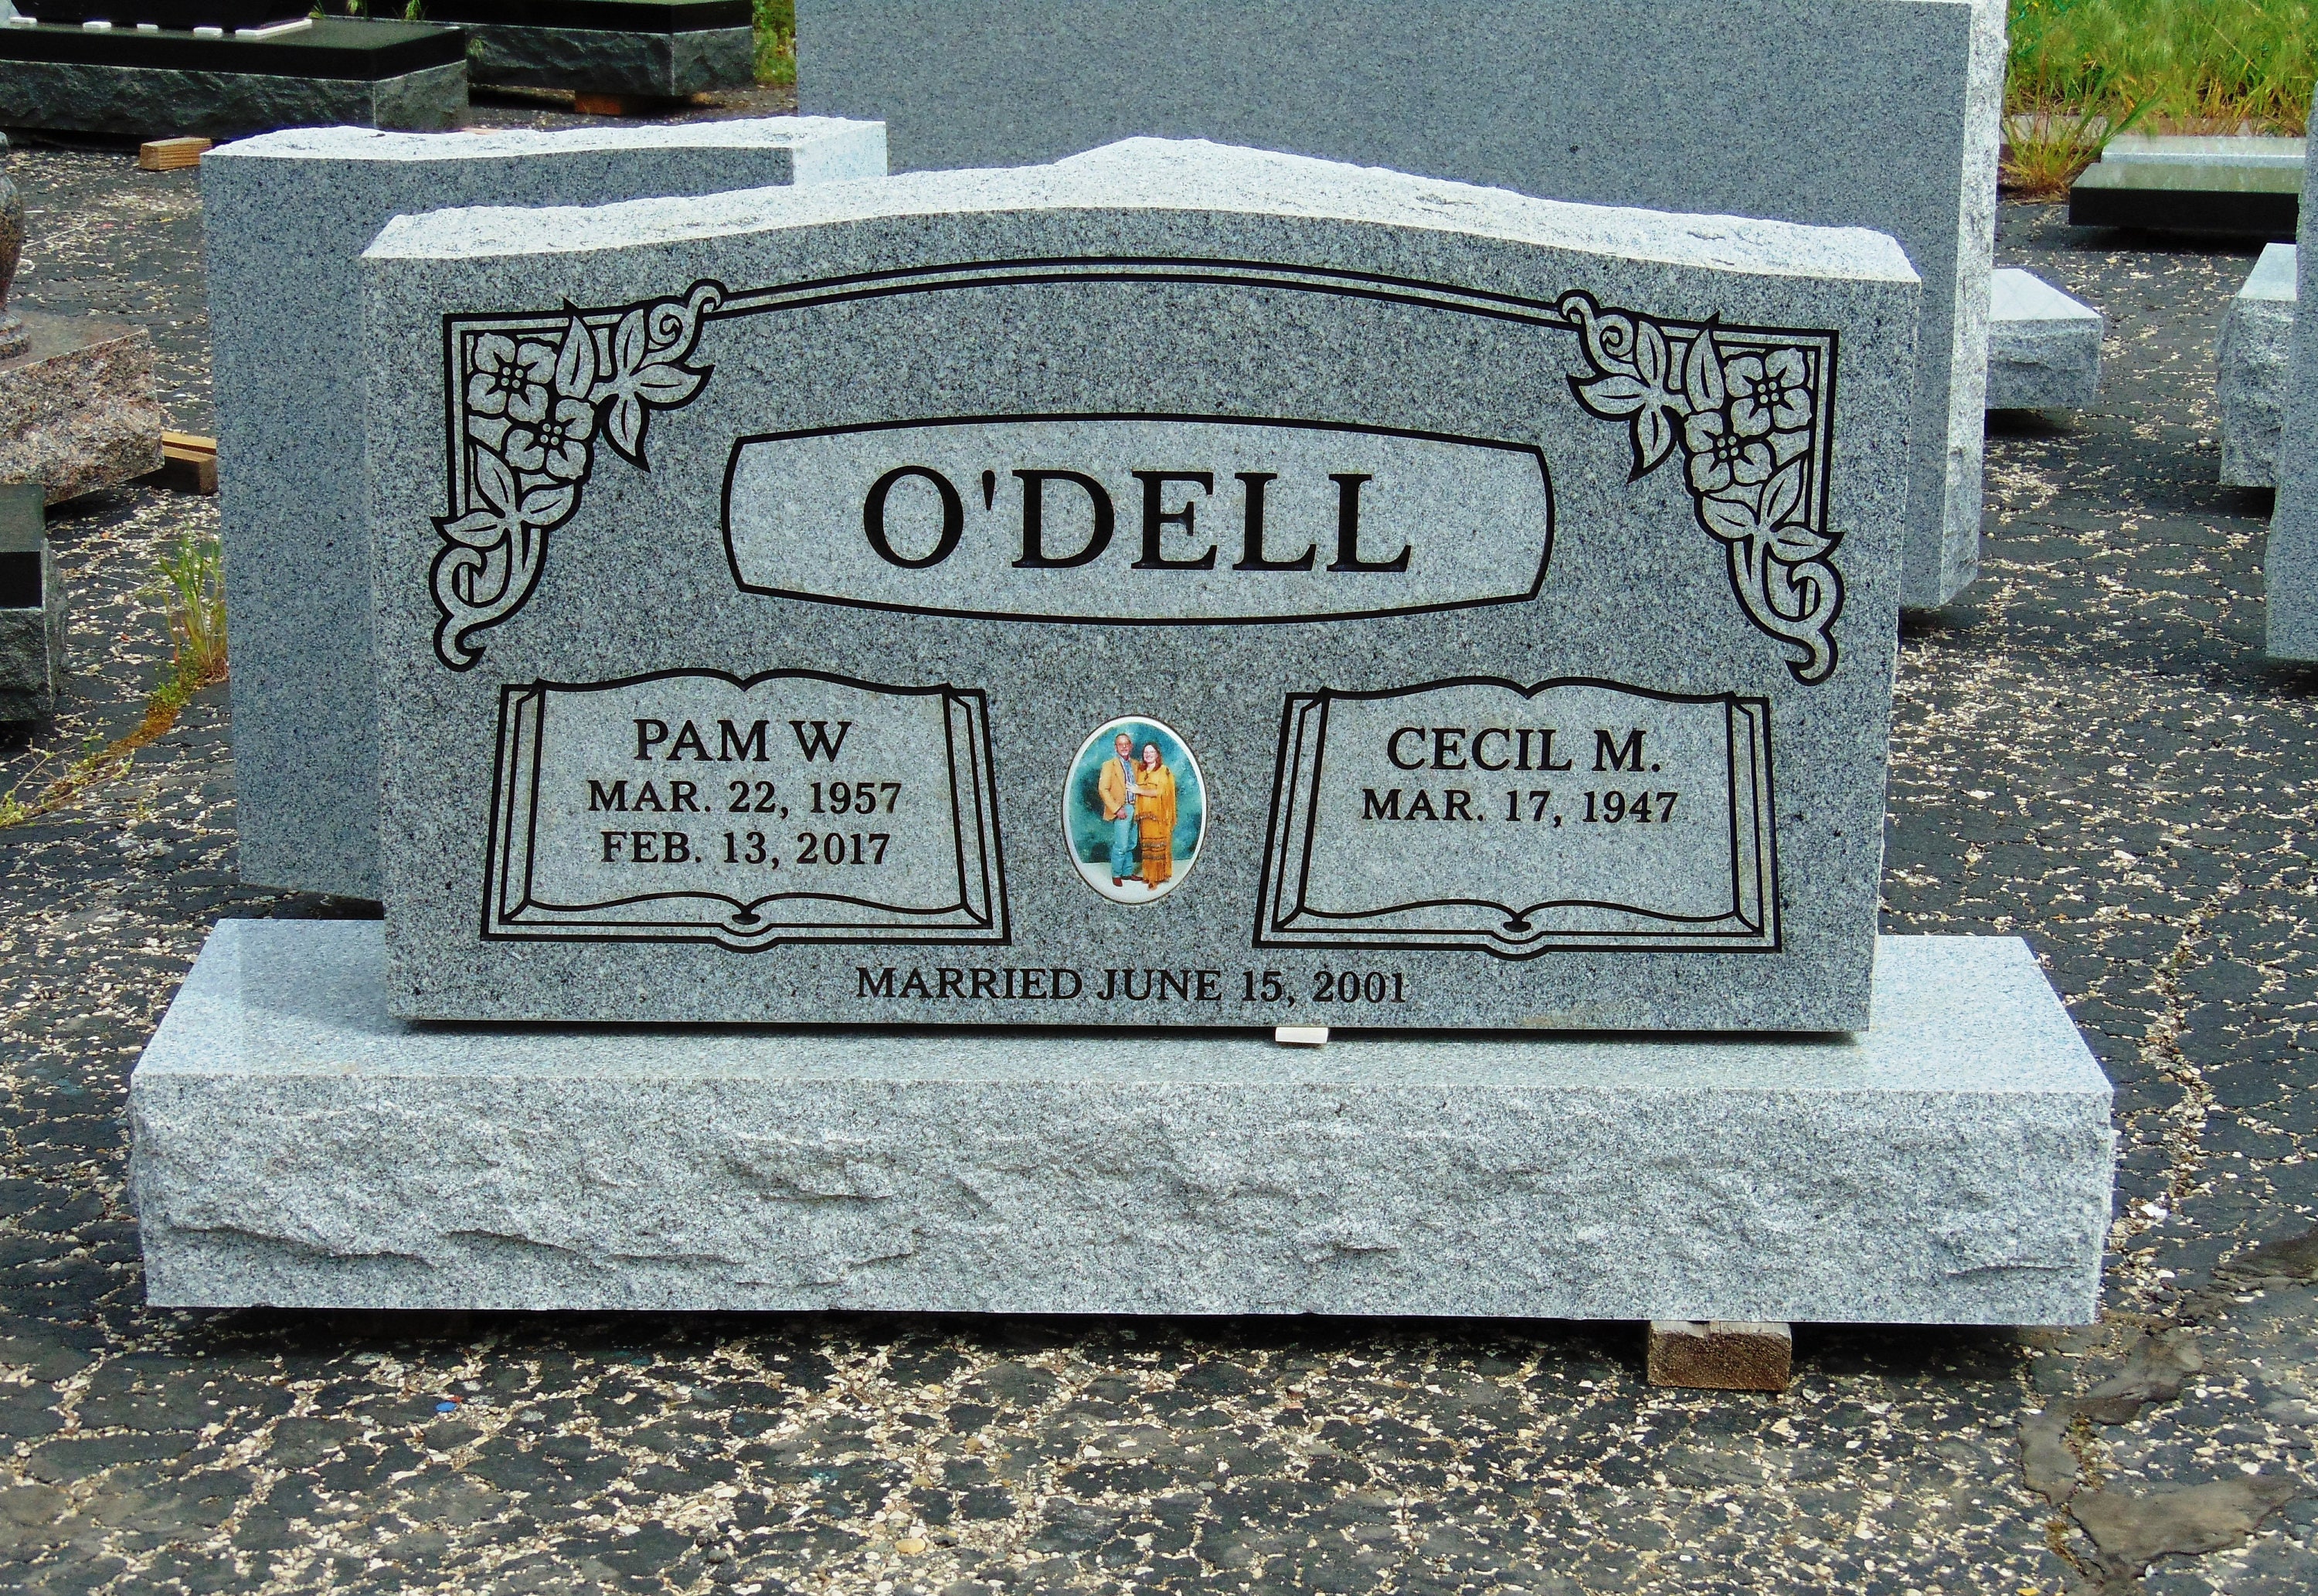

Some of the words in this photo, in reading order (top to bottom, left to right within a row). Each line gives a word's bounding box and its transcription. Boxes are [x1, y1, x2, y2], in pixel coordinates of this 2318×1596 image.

[863, 465, 1412, 572] O'DELL
[634, 718, 770, 762] PAM
[789, 720, 851, 762] W
[1387, 727, 1572, 771] CECIL
[1592, 728, 1660, 773] M.
[588, 780, 710, 812] MAR.
[729, 780, 788, 819] 22,
[811, 782, 902, 814] 1957
[1362, 788, 1484, 821] MAR.
[1507, 790, 1562, 828] 17,
[1583, 790, 1678, 823] 1947
[601, 831, 701, 863] FEB.
[724, 831, 779, 869] 13,
[797, 832, 890, 865] 2017
[856, 967, 1083, 1000] MARRIED
[1096, 968, 1222, 1002] JUNE
[1242, 970, 1296, 1007] 15,
[1313, 970, 1405, 1003] 2001
